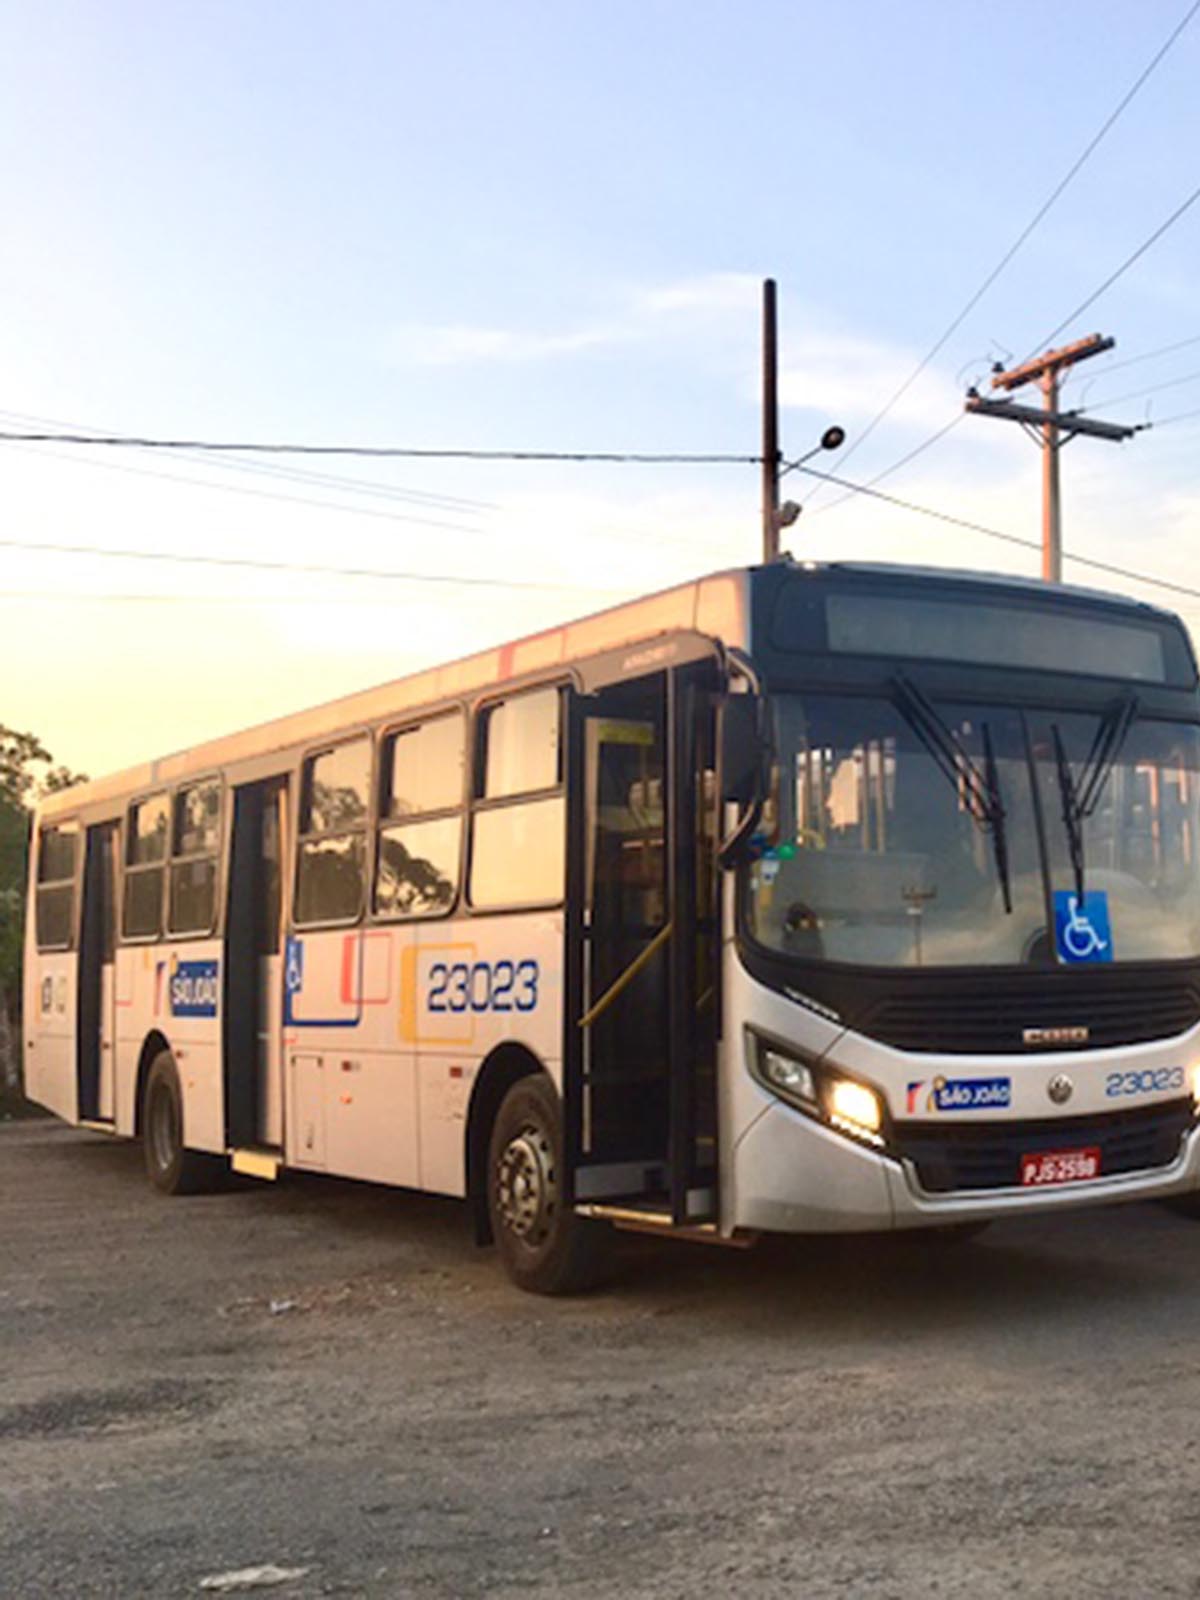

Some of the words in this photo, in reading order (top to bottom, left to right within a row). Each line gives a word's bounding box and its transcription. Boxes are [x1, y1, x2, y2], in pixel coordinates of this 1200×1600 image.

[428, 960, 539, 1012] 23023
[940, 1083, 971, 1106] SÃO
[971, 1082, 1010, 1105] JOÃO
[1105, 1066, 1185, 1097] 23023
